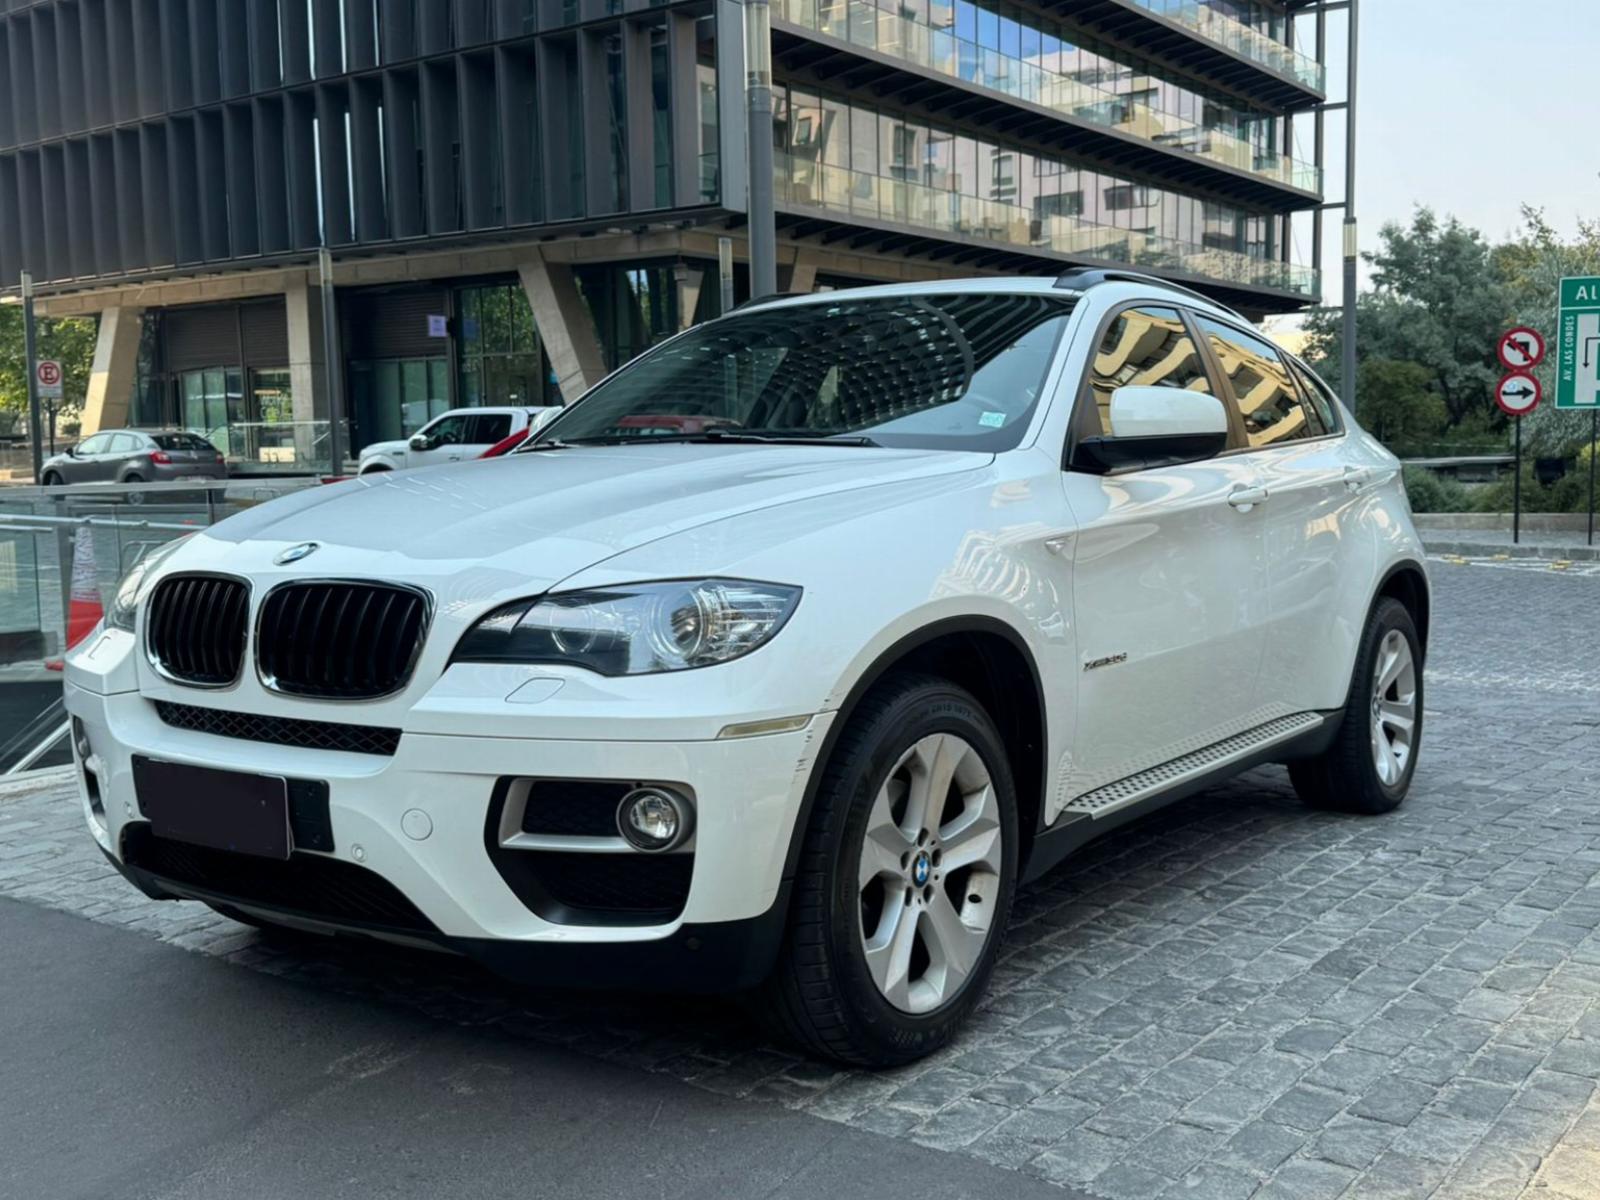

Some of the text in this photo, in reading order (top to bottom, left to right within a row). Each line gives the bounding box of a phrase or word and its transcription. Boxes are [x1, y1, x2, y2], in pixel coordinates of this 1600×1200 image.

[1563, 315, 1575, 381] AV. LAS CONDES
[43, 366, 55, 381] E
